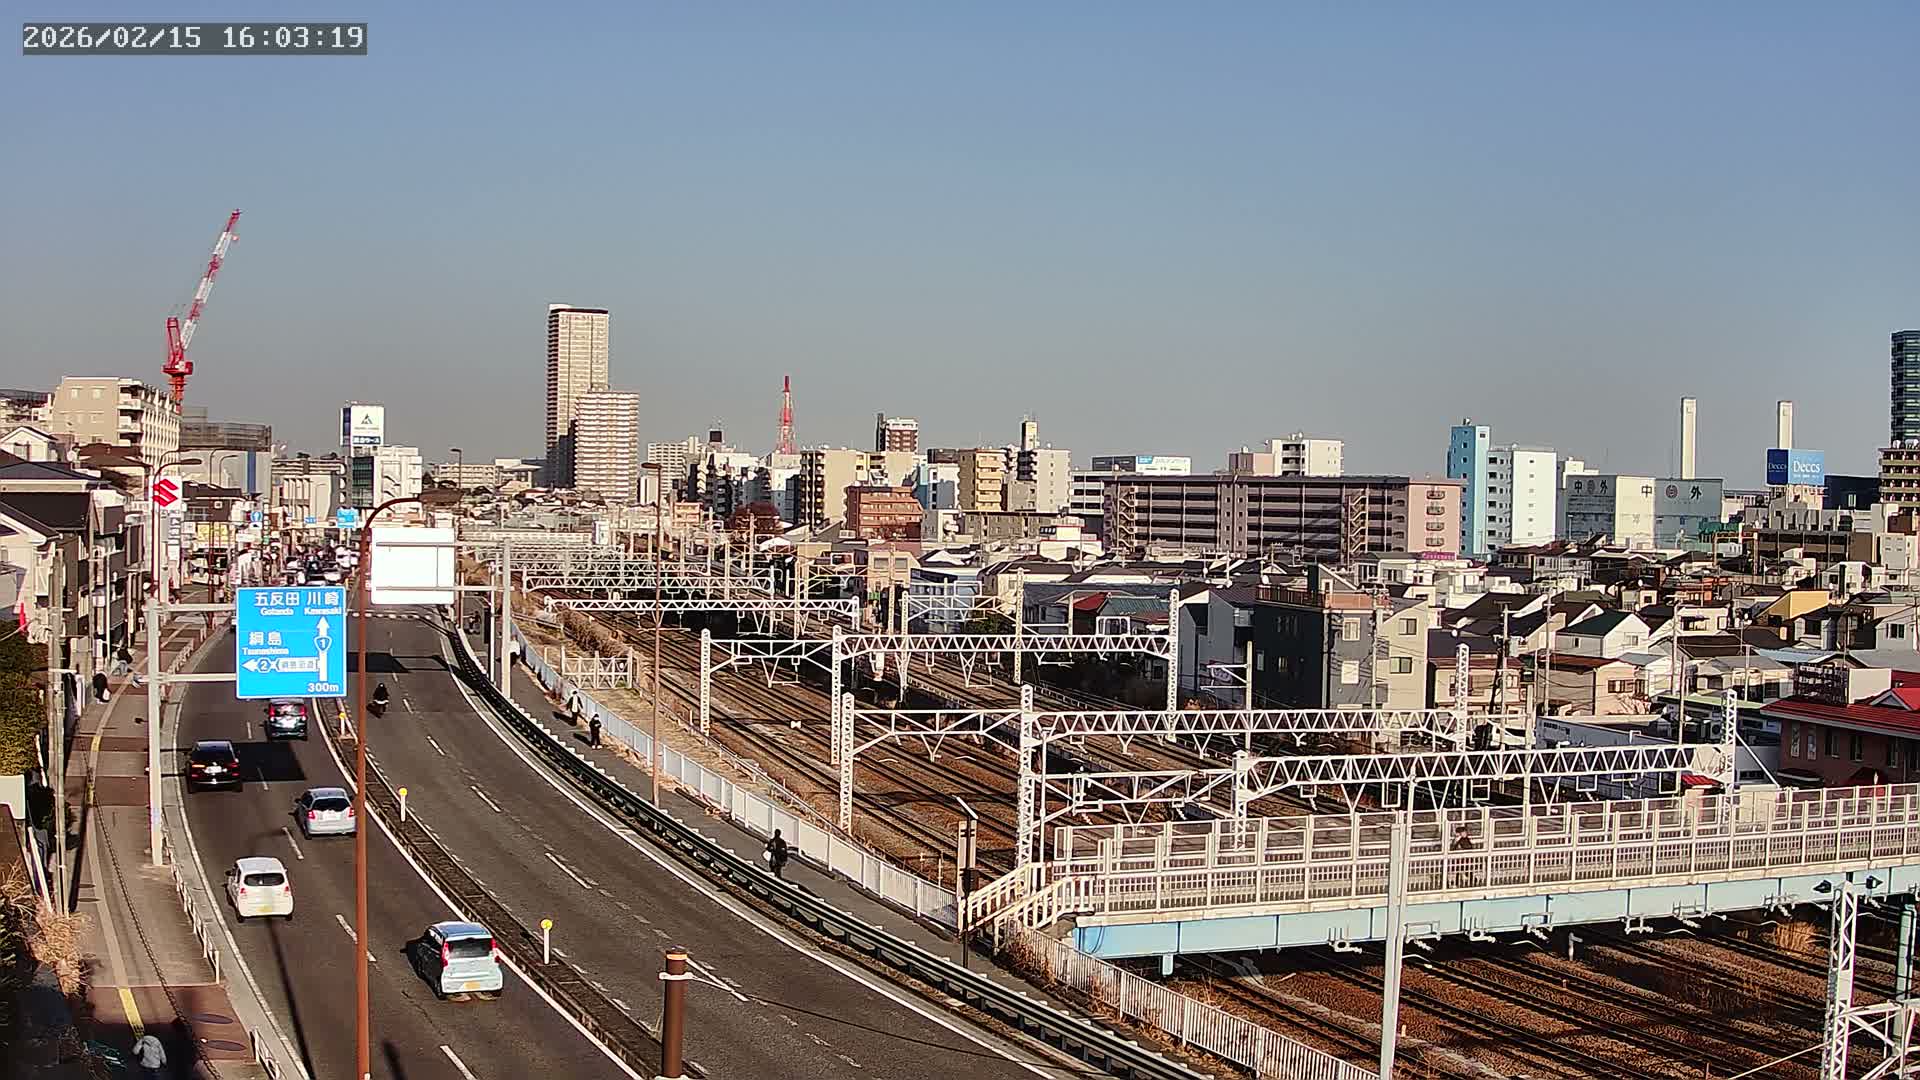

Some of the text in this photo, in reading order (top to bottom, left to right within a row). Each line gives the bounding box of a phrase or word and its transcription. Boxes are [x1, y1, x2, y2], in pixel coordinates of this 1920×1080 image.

[1793, 460, 1821, 473] Deccs
[254, 591, 339, 606] 五反田 川崎
[260, 661, 268, 670] 2
[307, 682, 339, 692] 300m
